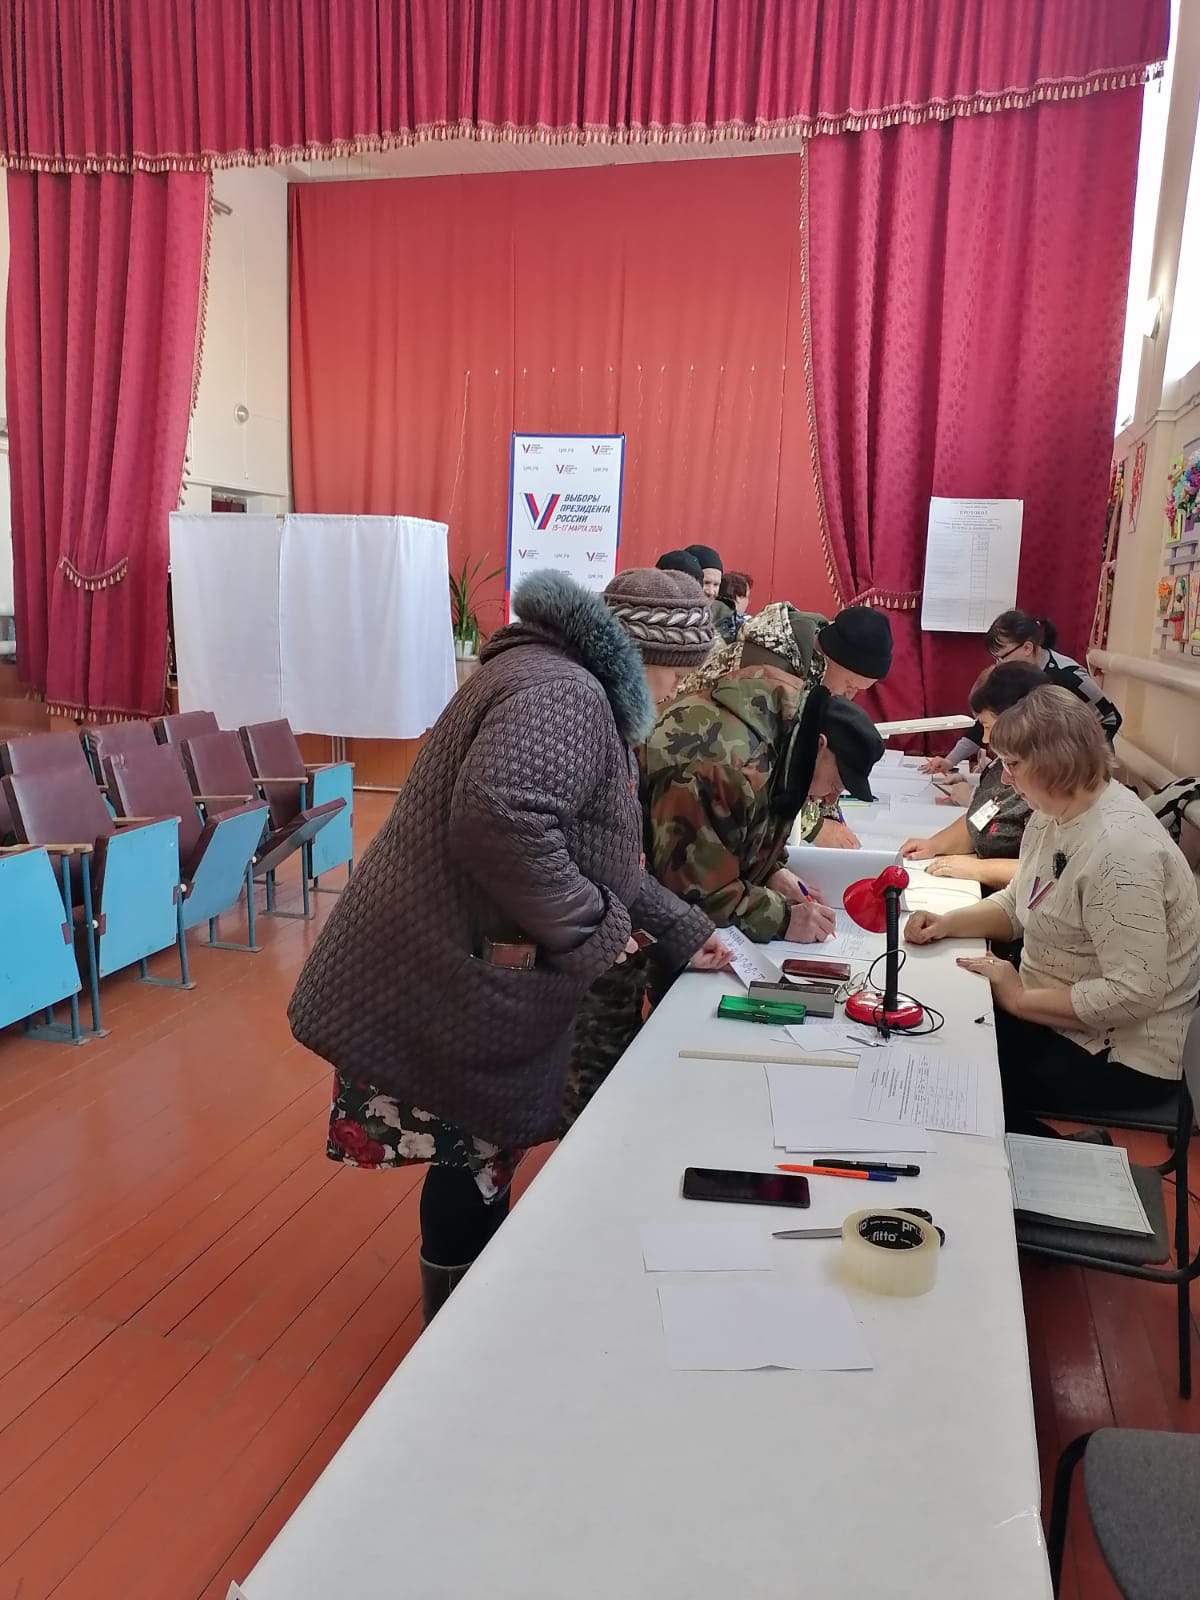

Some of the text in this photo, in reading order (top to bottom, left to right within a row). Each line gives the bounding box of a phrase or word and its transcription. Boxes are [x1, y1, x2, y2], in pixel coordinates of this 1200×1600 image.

[564, 494, 601, 503] ВЫБОРЫ
[560, 504, 611, 514] ПРЕЗИДЕНТА
[555, 514, 589, 523] РОССИИ
[568, 524, 588, 532] МАРТА
